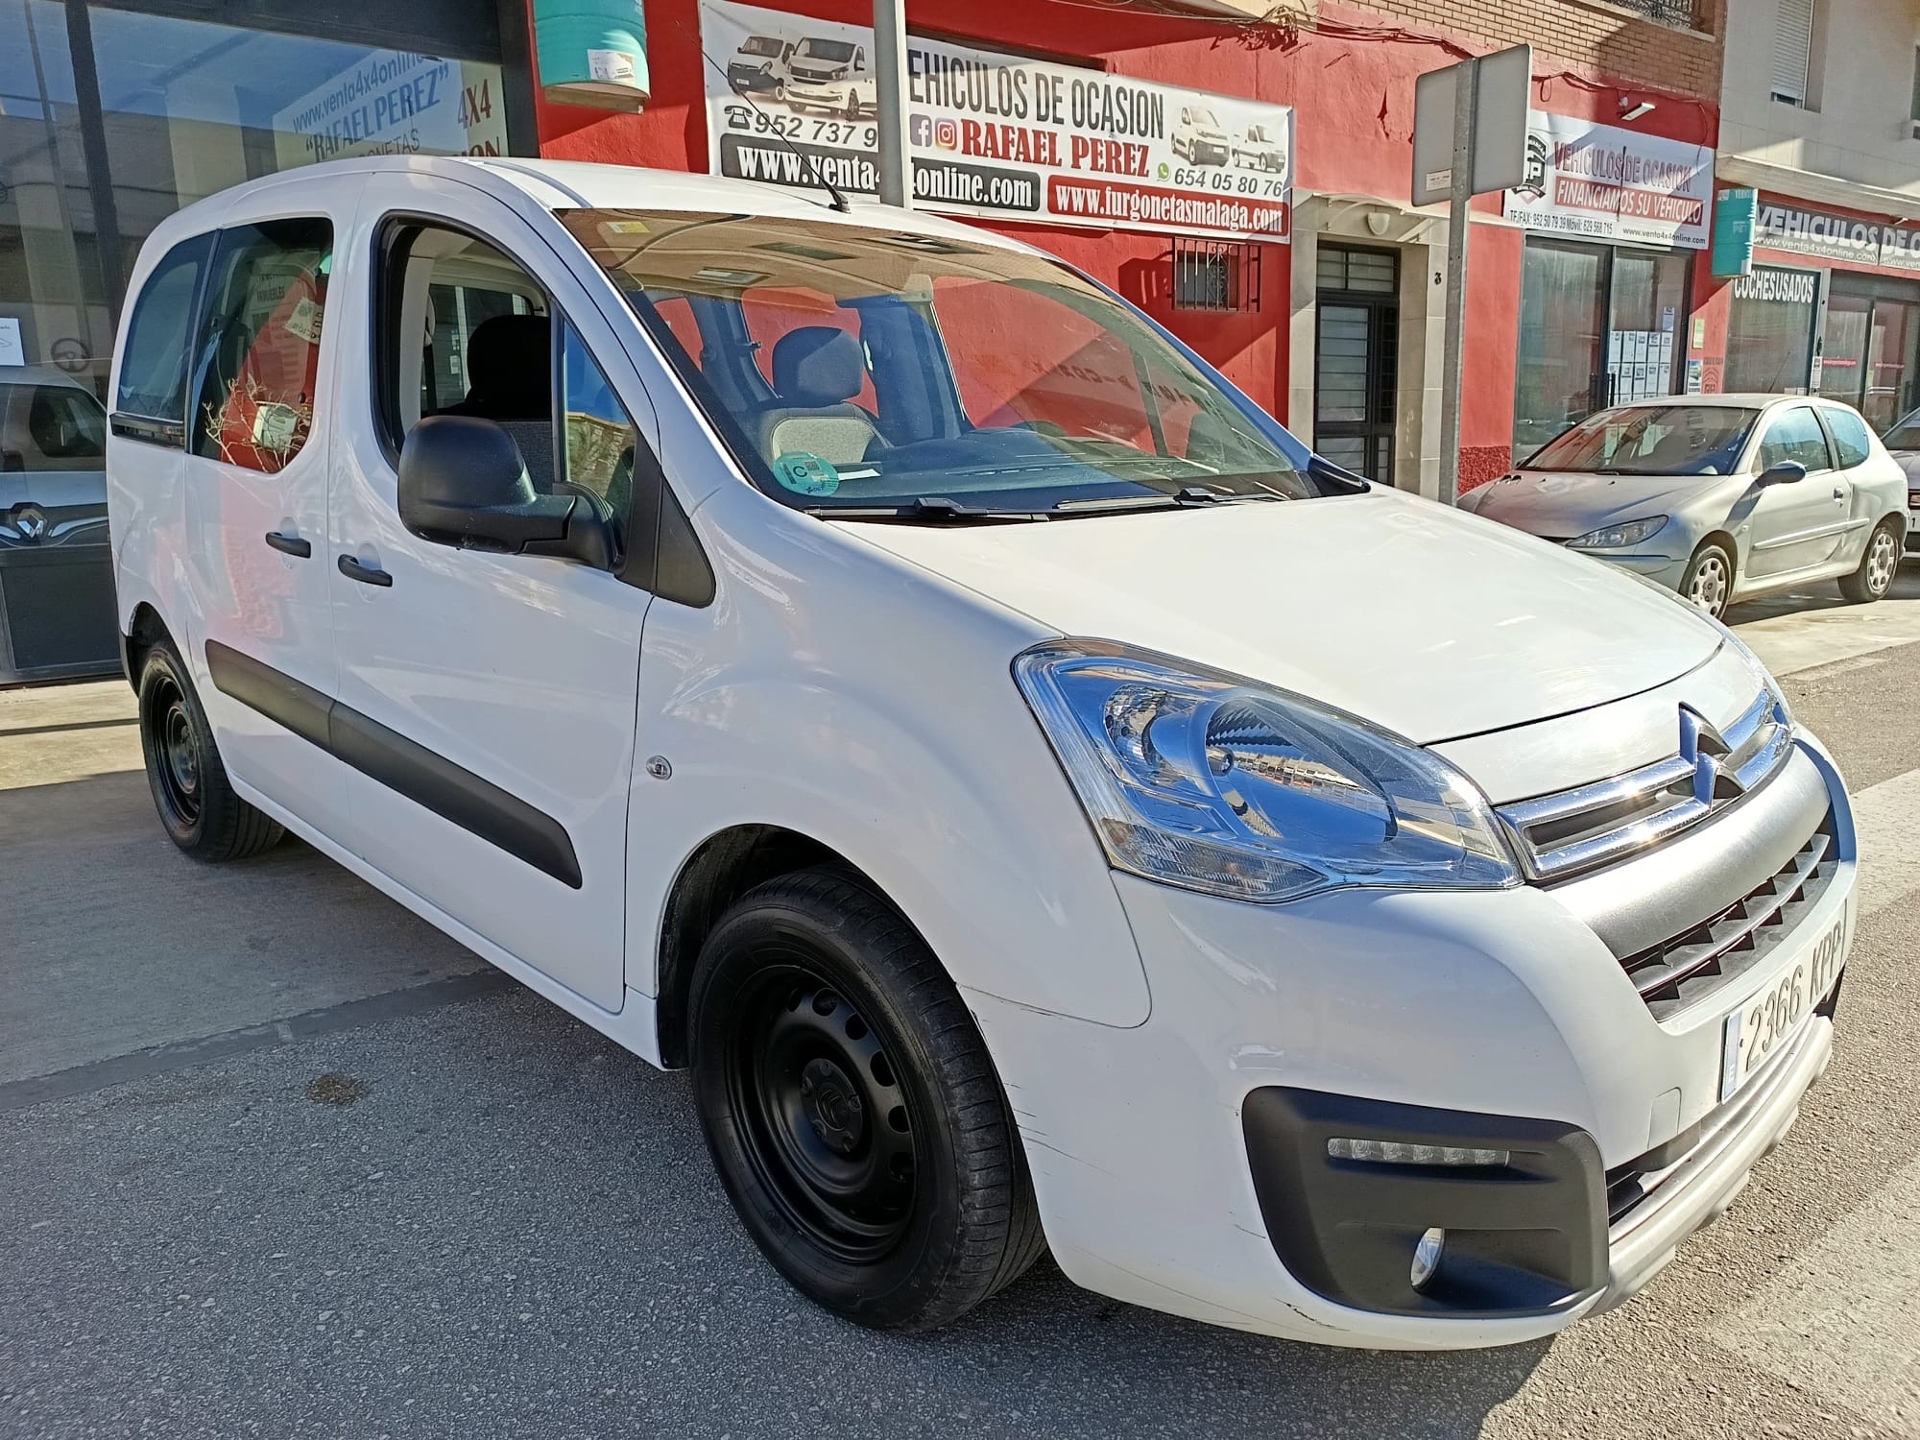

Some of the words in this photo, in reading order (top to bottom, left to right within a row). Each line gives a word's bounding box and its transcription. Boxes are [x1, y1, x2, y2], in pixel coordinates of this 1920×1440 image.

[457, 79, 492, 129] 4X4
[908, 49, 1028, 120] EHICULOS
[1035, 73, 1065, 125] DE
[1072, 79, 1163, 139] OCASION
[755, 113, 803, 138] 952
[812, 120, 857, 144] 737
[961, 118, 1062, 167] RAFAEL
[1070, 134, 1150, 178] PEREZ
[1175, 168, 1206, 187] 654
[1212, 173, 1233, 191] 05
[1238, 177, 1258, 194] 80
[1264, 180, 1284, 197] 76
[1554, 141, 1623, 181] VEHICULOS
[1625, 156, 1641, 183] DE
[1643, 160, 1692, 192] OCASION
[1056, 185, 1283, 233] www.furgonetasmalaga.com
[1557, 180, 1635, 213] FINANCIAMOS
[1636, 192, 1652, 216] SU
[1654, 196, 1701, 224] VEHICULO
[1756, 204, 1879, 251] VEHICULOS
[1881, 227, 1907, 257] DE
[793, 466, 807, 477] C
[1745, 964, 1804, 1072] 2366
[1809, 920, 1842, 1005] KPP
